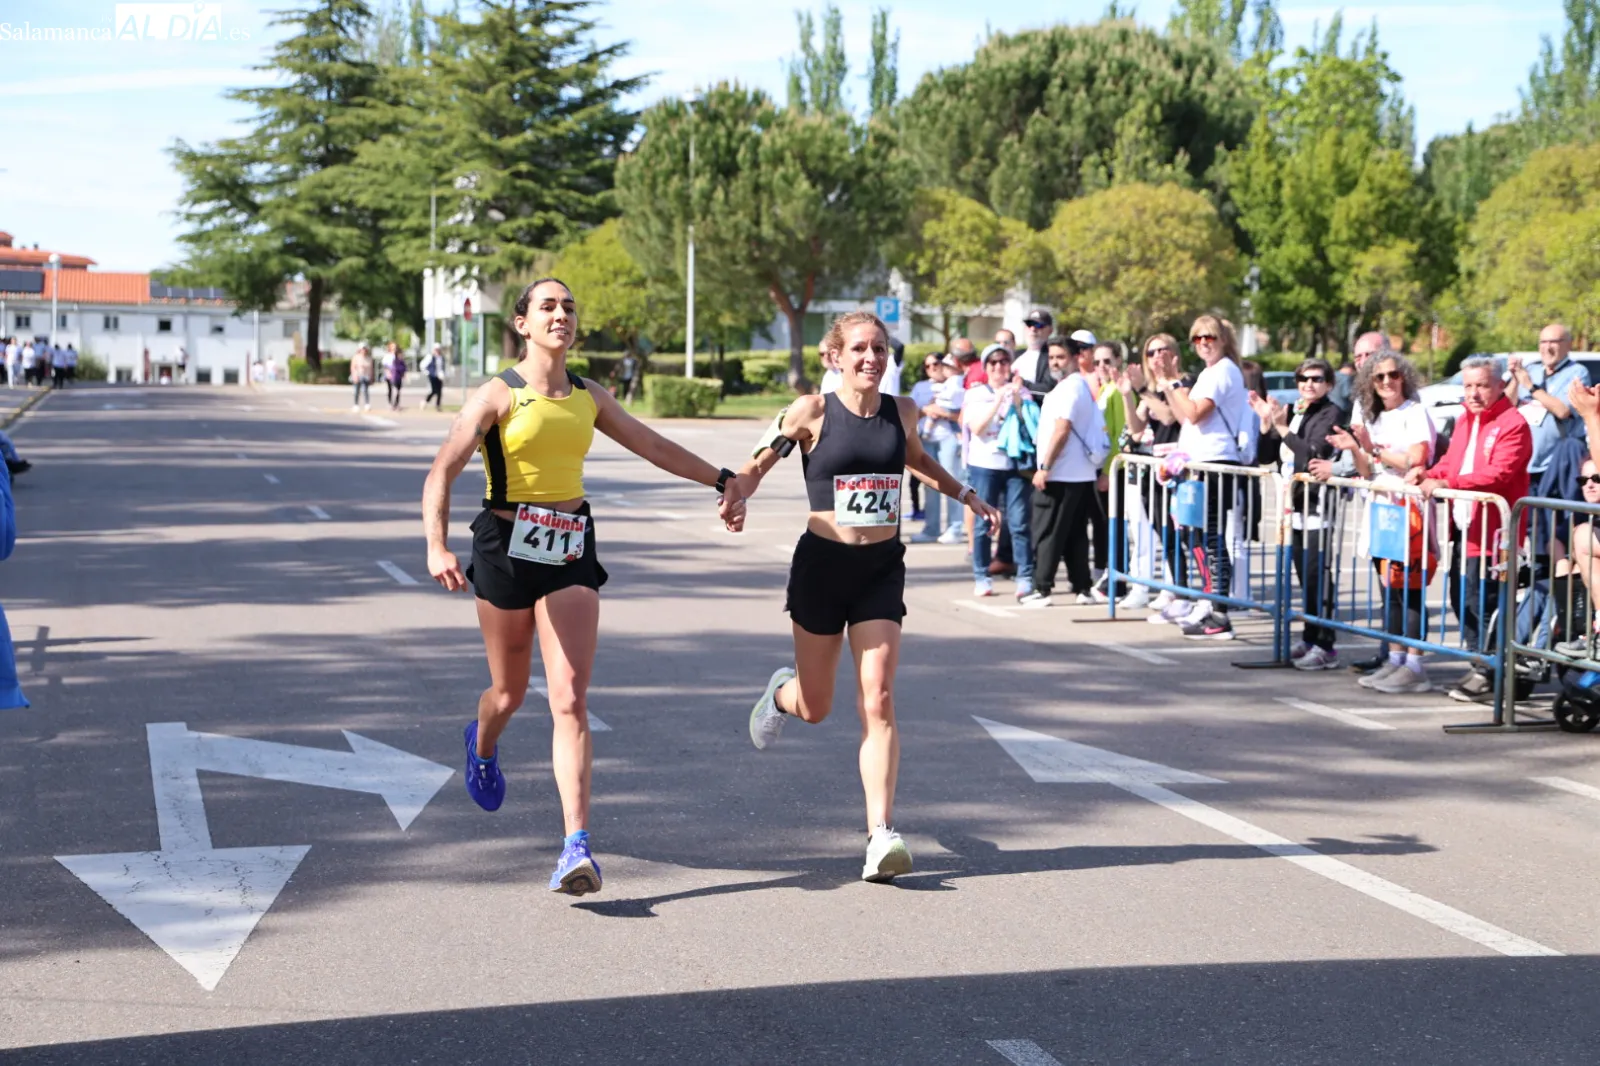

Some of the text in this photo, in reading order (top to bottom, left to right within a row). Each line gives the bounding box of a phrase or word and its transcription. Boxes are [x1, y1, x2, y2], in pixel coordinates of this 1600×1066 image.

[880, 298, 894, 315] P
[836, 477, 899, 491] bedunia
[848, 490, 892, 514] 424
[523, 526, 572, 554] 411
